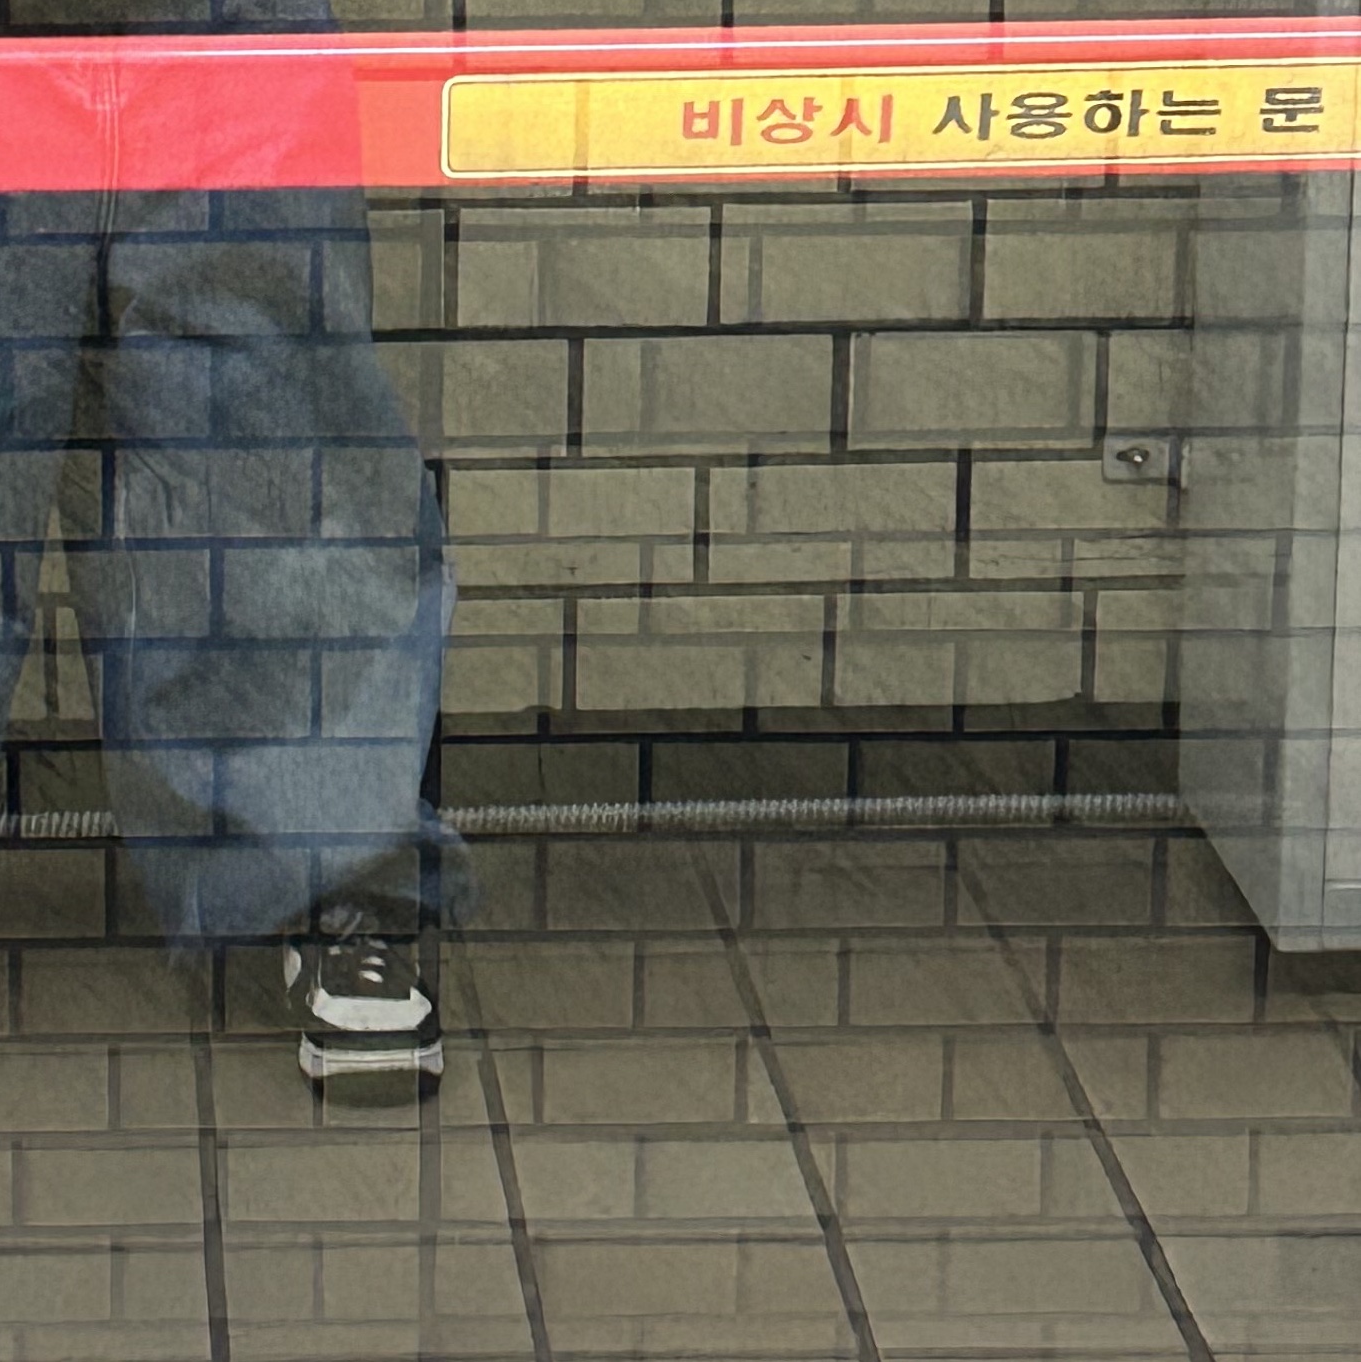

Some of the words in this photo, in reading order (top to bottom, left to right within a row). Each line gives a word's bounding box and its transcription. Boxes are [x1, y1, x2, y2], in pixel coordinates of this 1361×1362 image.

[683, 94, 893, 146] 비상시
[932, 89, 1221, 141] 사용하는
[1259, 87, 1324, 133] 문
